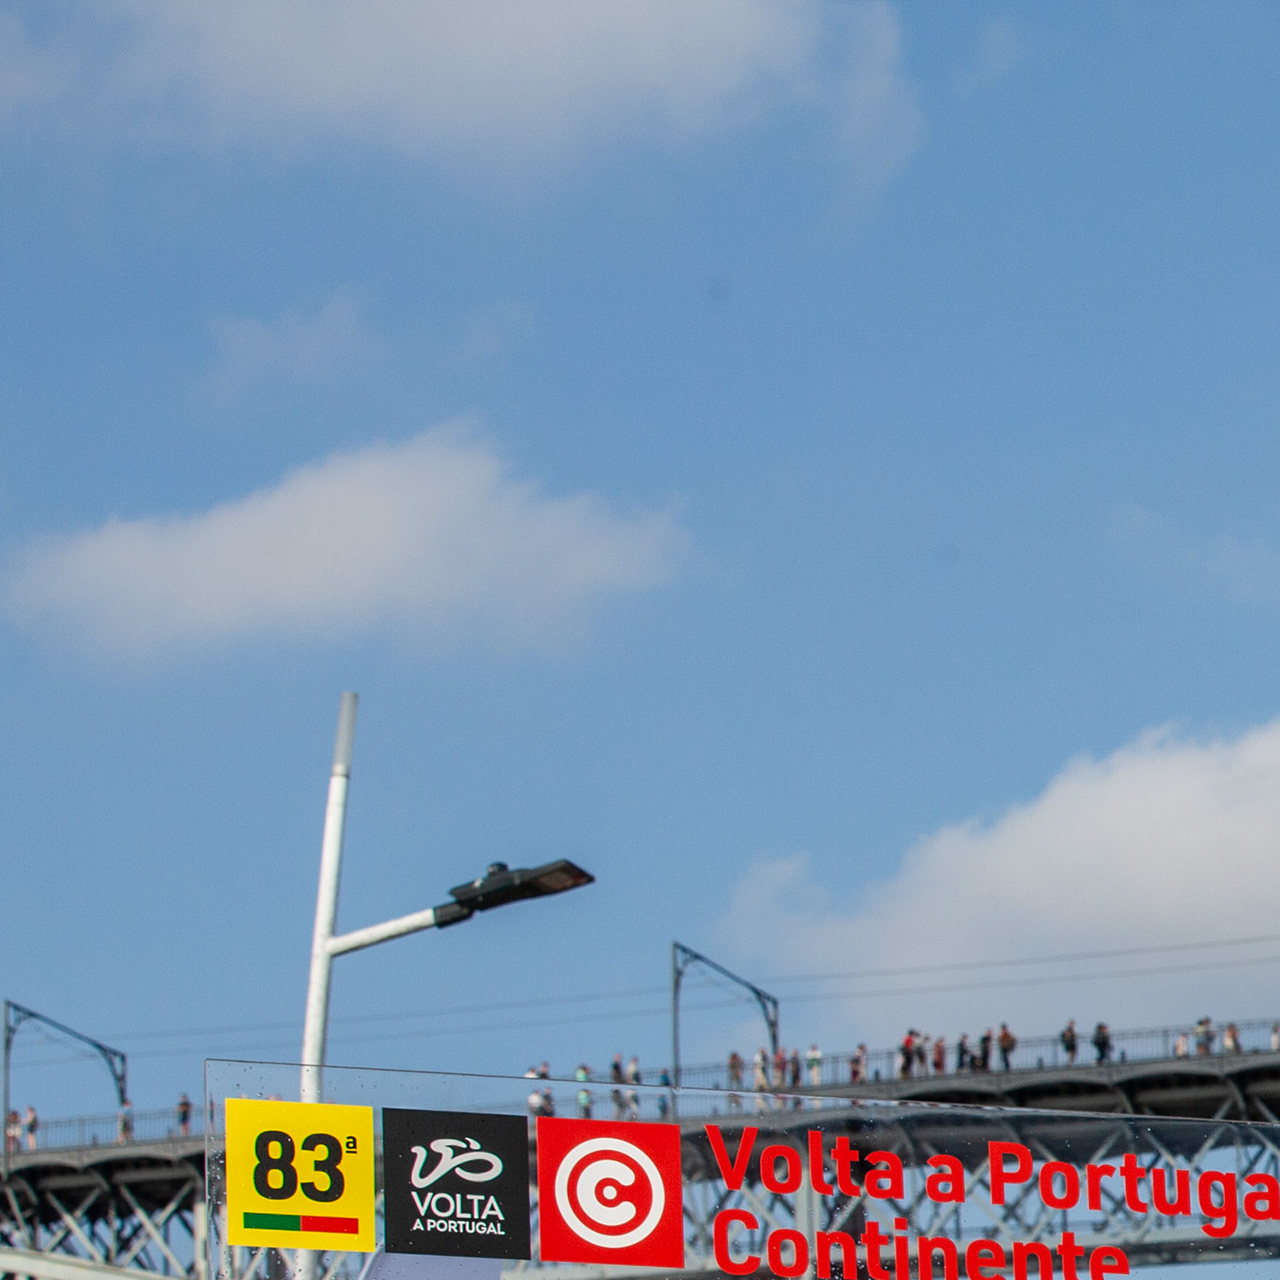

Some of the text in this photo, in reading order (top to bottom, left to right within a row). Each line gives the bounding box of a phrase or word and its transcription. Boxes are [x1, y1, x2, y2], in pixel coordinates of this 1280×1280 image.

[704, 1124, 905, 1200] Volta
[926, 1153, 966, 1205] a
[411, 1191, 505, 1222] VOLTA
[413, 1219, 506, 1236] A PORTUGAL
